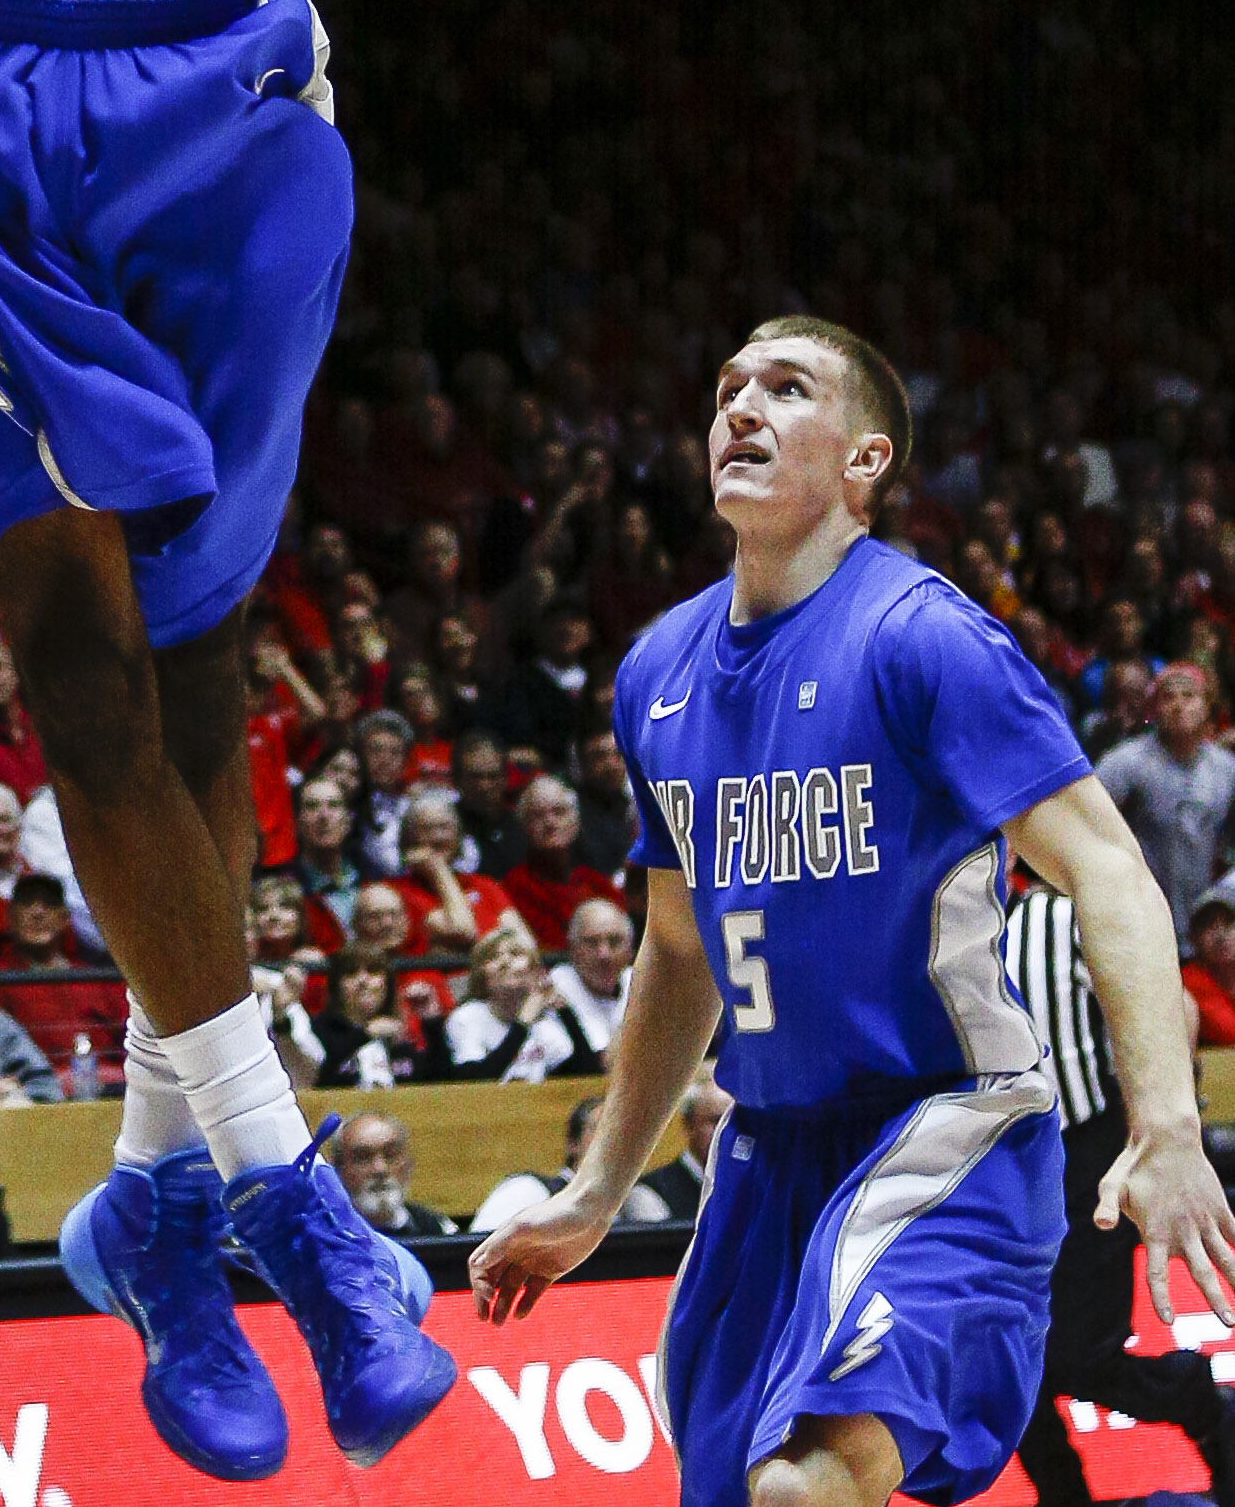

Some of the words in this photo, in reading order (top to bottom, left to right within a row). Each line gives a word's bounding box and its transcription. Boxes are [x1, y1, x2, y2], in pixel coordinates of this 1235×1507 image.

[714, 764, 880, 889] FORCE
[721, 909, 776, 1034] 5
[467, 1353, 674, 1481] YO
